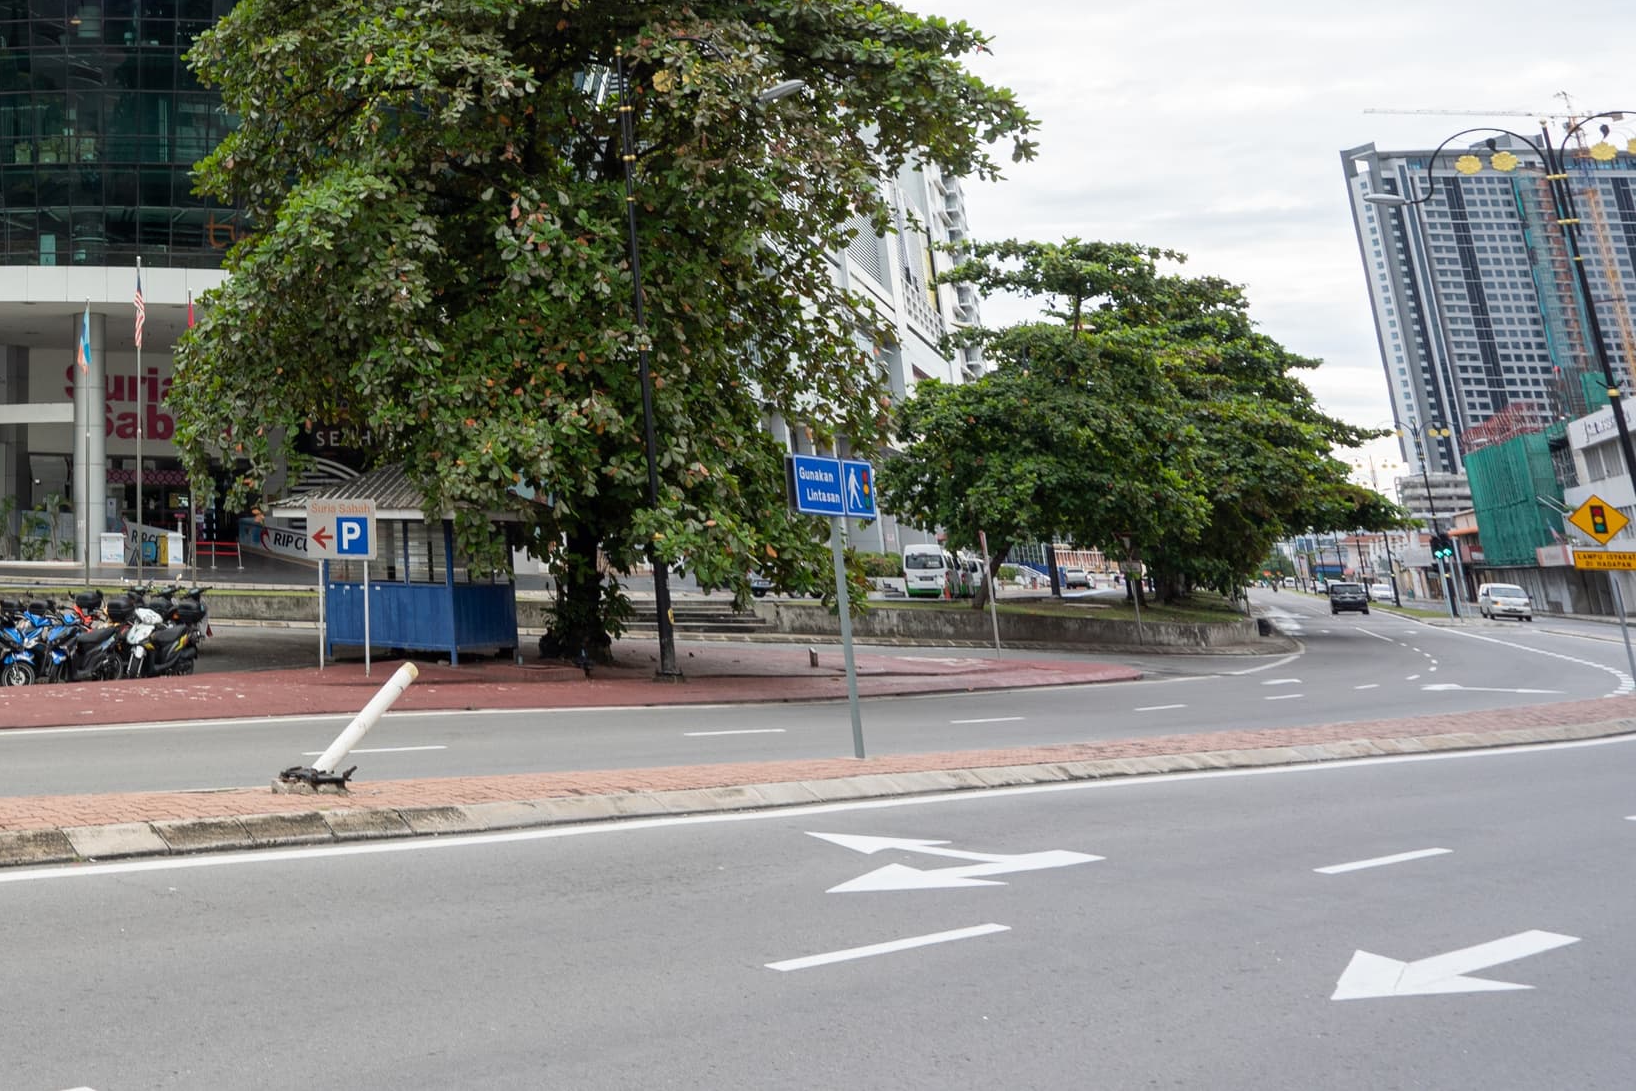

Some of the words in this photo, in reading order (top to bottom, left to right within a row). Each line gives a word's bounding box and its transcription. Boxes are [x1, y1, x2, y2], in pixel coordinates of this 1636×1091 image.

[799, 466, 834, 483] Gunakan
[806, 487, 841, 504] Lintasan
[312, 503, 336, 515] Suria
[339, 503, 370, 515] Sabah
[273, 531, 294, 548] RIP
[341, 521, 362, 550] P
